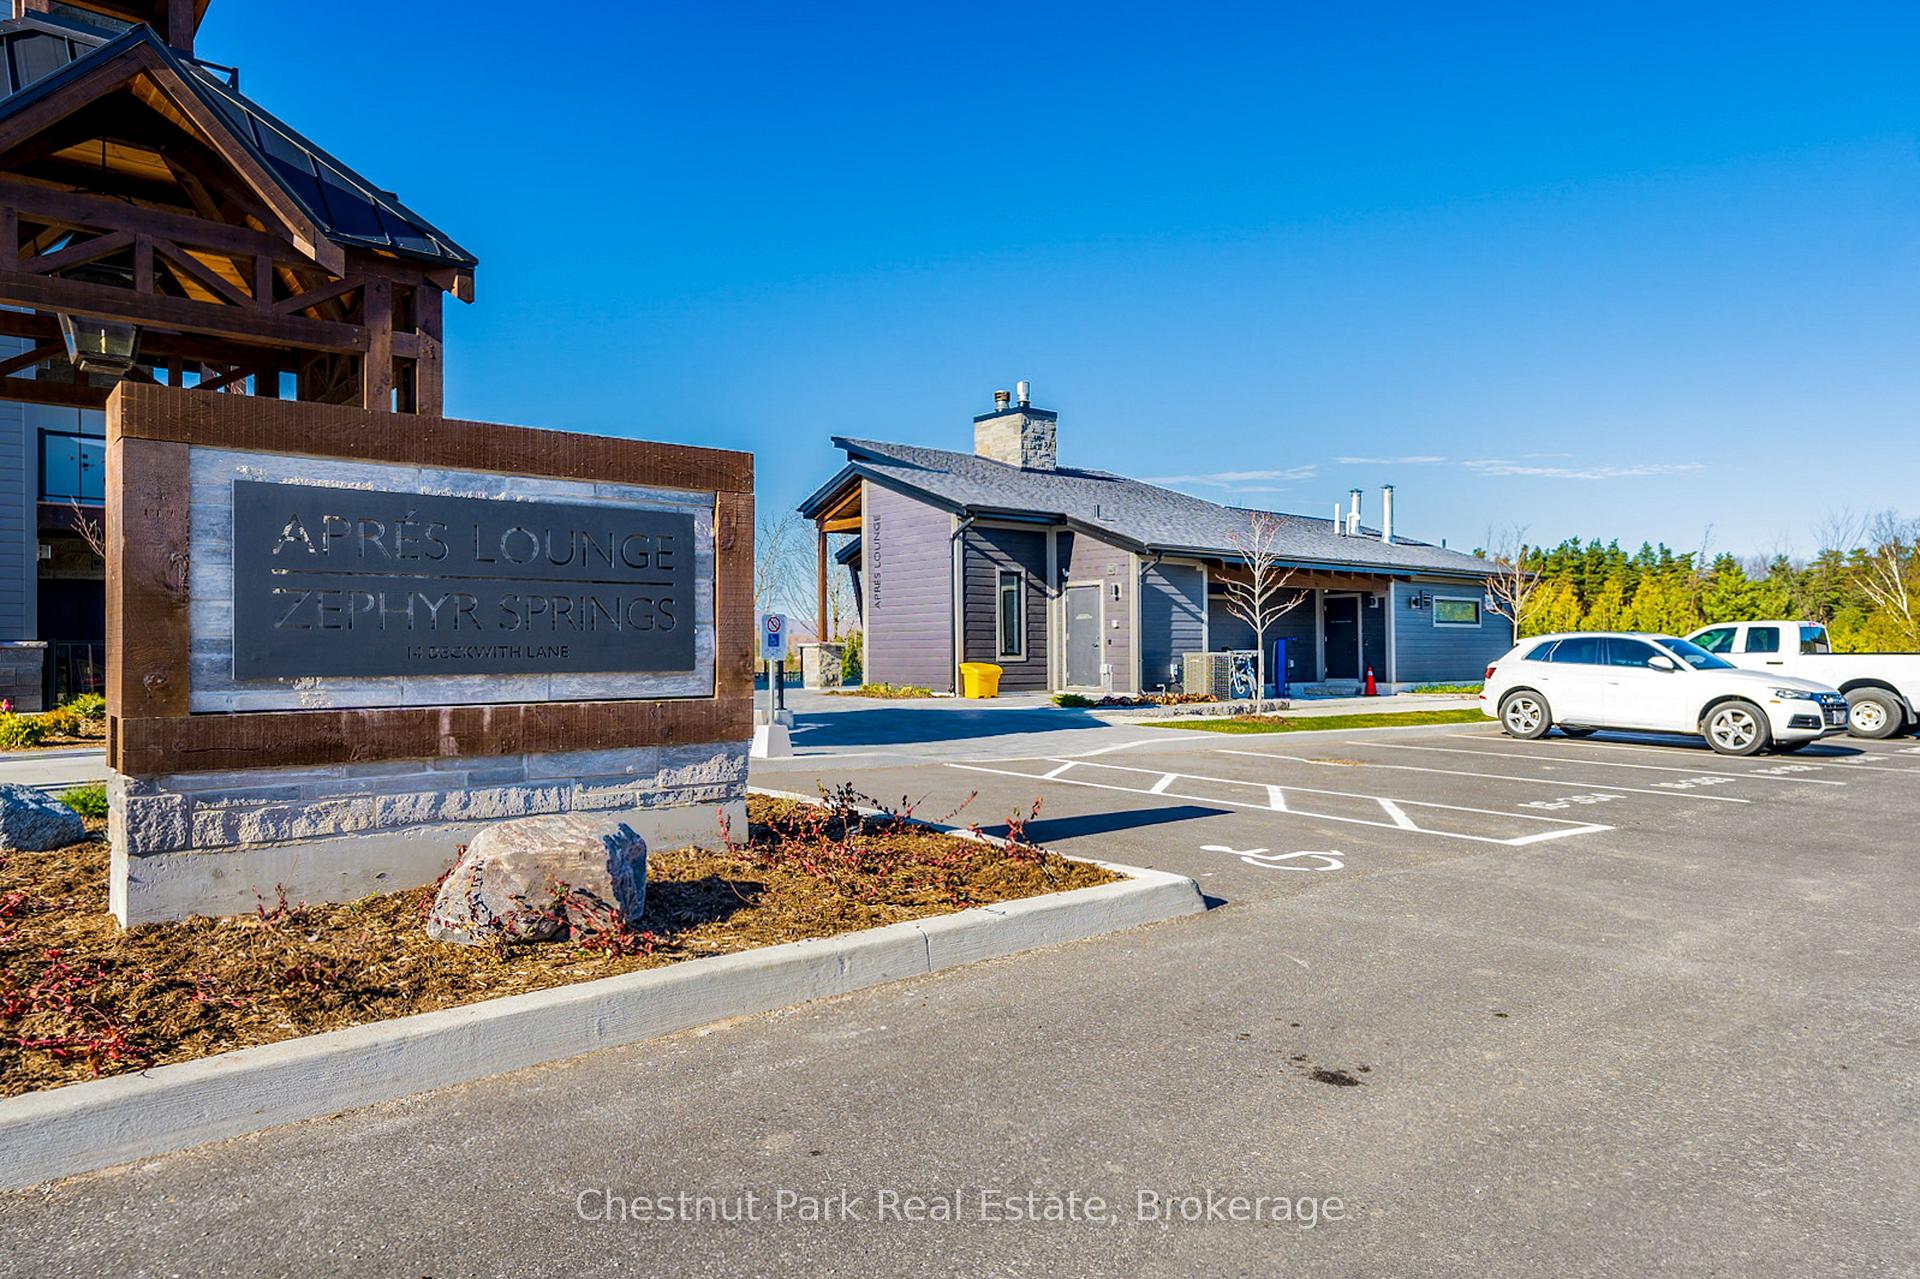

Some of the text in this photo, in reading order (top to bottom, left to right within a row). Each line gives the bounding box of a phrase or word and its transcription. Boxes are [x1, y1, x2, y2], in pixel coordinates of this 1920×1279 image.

[272, 508, 676, 570] APRÉS LOUNGE
[873, 515, 882, 569] LOUNGE
[273, 587, 677, 633] ZEPHYR SPRINGS
[428, 646, 521, 660] BECKWITH
[527, 645, 569, 659] LANE
